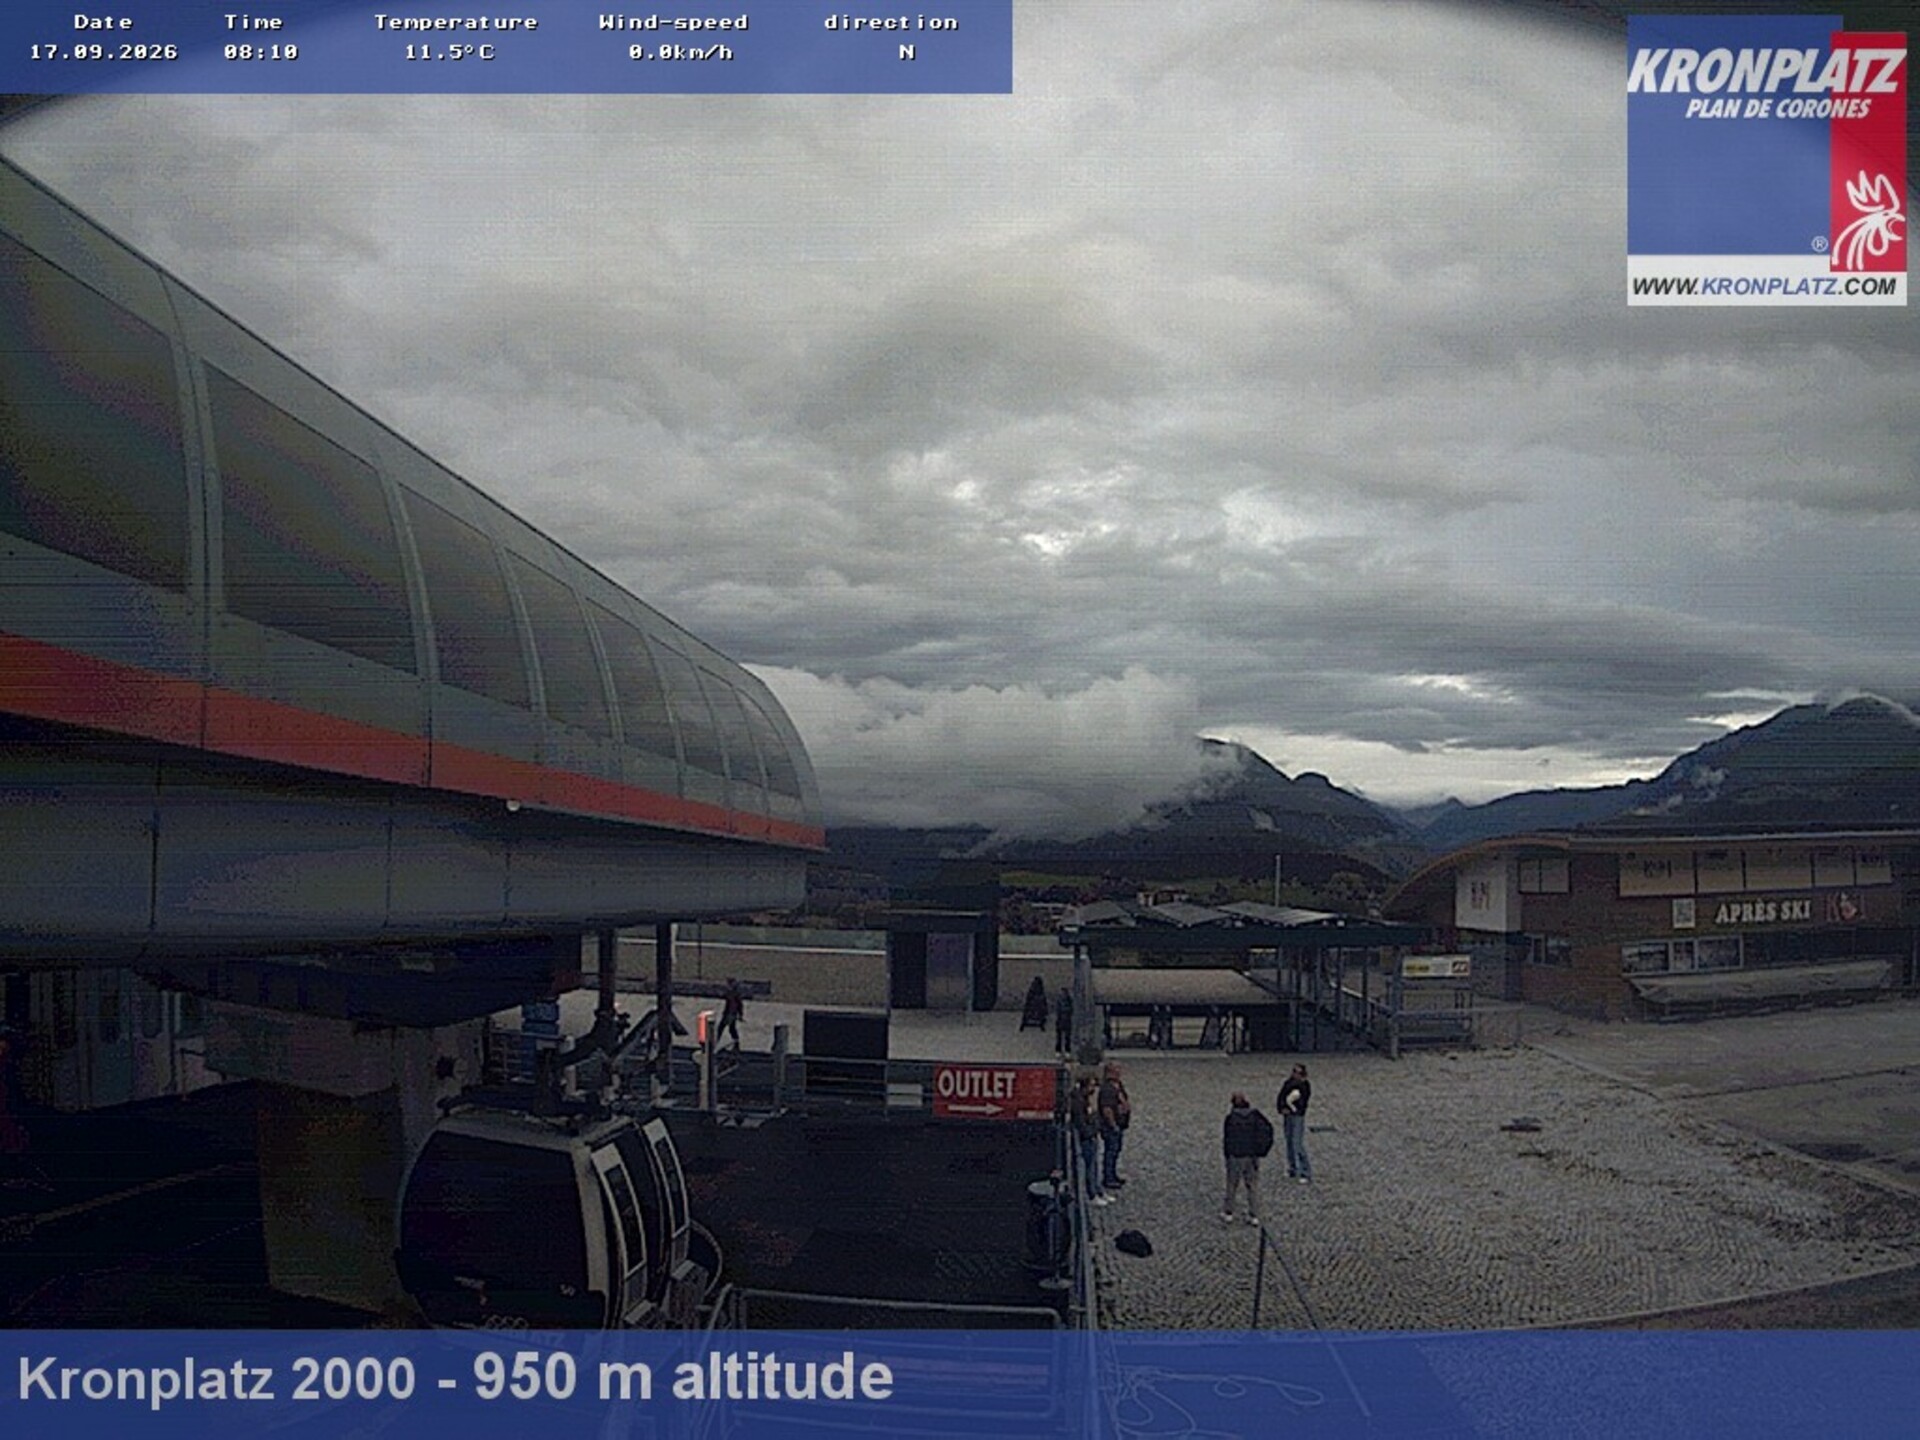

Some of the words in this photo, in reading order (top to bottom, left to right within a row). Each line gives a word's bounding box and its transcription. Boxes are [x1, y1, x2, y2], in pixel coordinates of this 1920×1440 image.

[1714, 898, 1777, 924] APRÈS
[1779, 899, 1812, 920] SKI
[937, 1069, 1017, 1099] OUTLET
